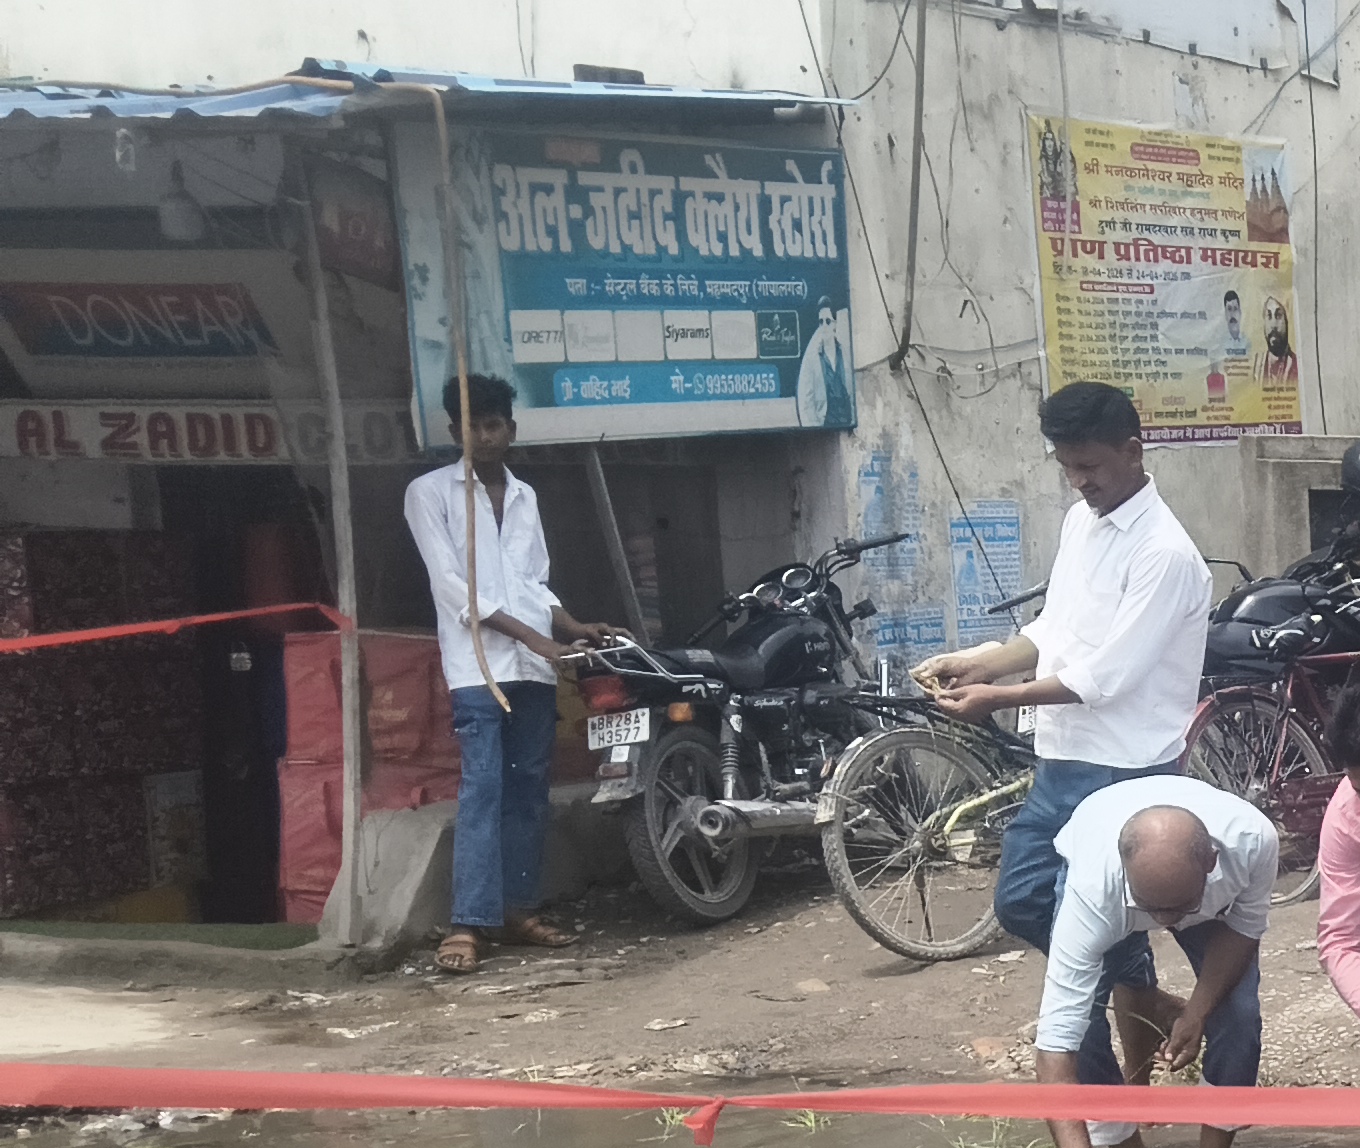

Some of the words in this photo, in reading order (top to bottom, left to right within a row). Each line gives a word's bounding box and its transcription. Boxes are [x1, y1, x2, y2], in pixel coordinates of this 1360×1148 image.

[1083, 158, 1100, 175] श्री
[1049, 237, 1107, 260] प्राण
[1112, 238, 1193, 265] प्रतिष्ठा
[1199, 247, 1281, 270] महायज्ञ
[564, 278, 588, 295] पता
[638, 272, 660, 297] बैंक
[661, 273, 676, 297] के
[48, 294, 250, 347] DONEAR
[664, 323, 710, 342] Siyarams
[16, 409, 86, 459] AL
[99, 410, 283, 460] ZADID
[597, 711, 641, 730] BR28A
